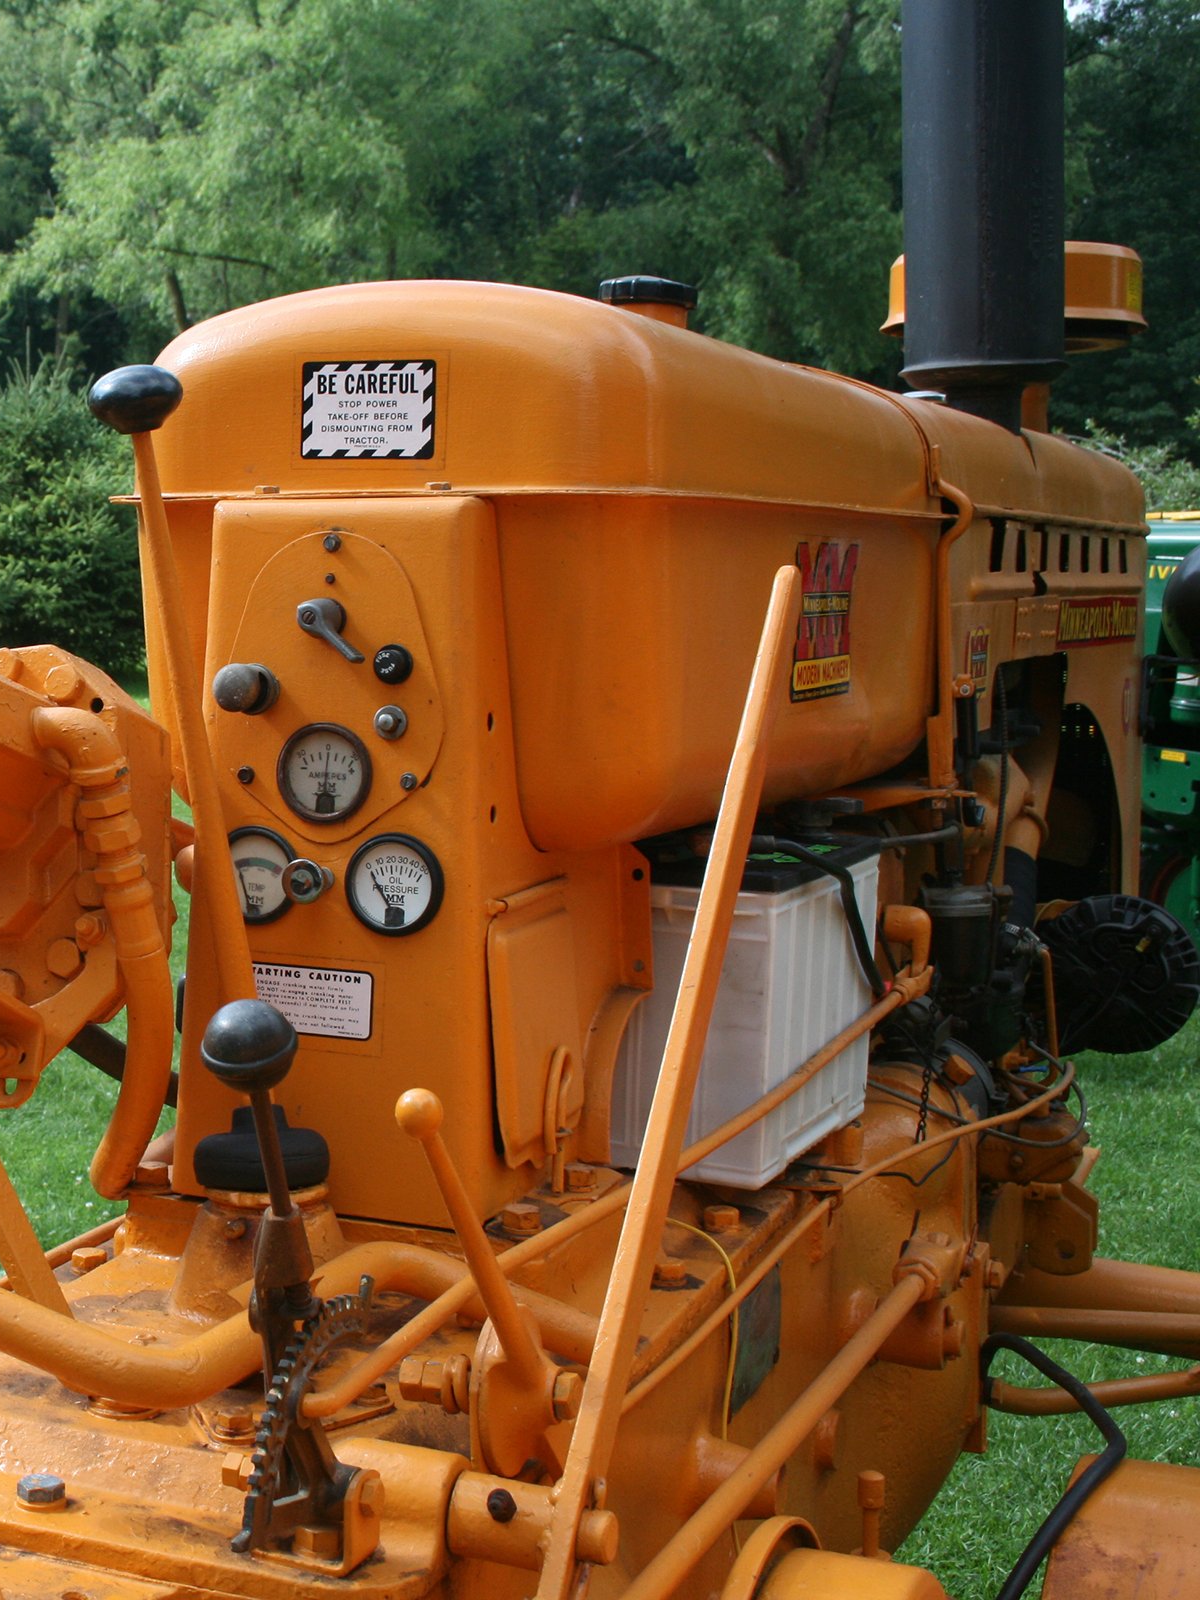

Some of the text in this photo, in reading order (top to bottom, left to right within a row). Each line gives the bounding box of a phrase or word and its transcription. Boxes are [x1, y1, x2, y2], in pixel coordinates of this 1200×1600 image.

[317, 373, 419, 394] BE CAREFUL
[366, 400, 398, 408] POWER
[328, 413, 369, 421] TAKE-OFF
[321, 425, 383, 433] DISMOUNTING
[376, 652, 390, 663] FUSE
[796, 661, 849, 688] MODERN MACHINERY
[365, 862, 372, 870] 0
[375, 857, 384, 866] 10
[397, 856, 409, 864] 30
[409, 859, 420, 868] 40
[419, 865, 429, 875] 50
[388, 876, 403, 884] OIL
[248, 882, 266, 892] TEMP
[372, 884, 419, 894] PRESSURE
[386, 894, 405, 904] MM
[253, 966, 361, 984] TARTING CAUTION
[306, 996, 335, 1004] COMPLETE
